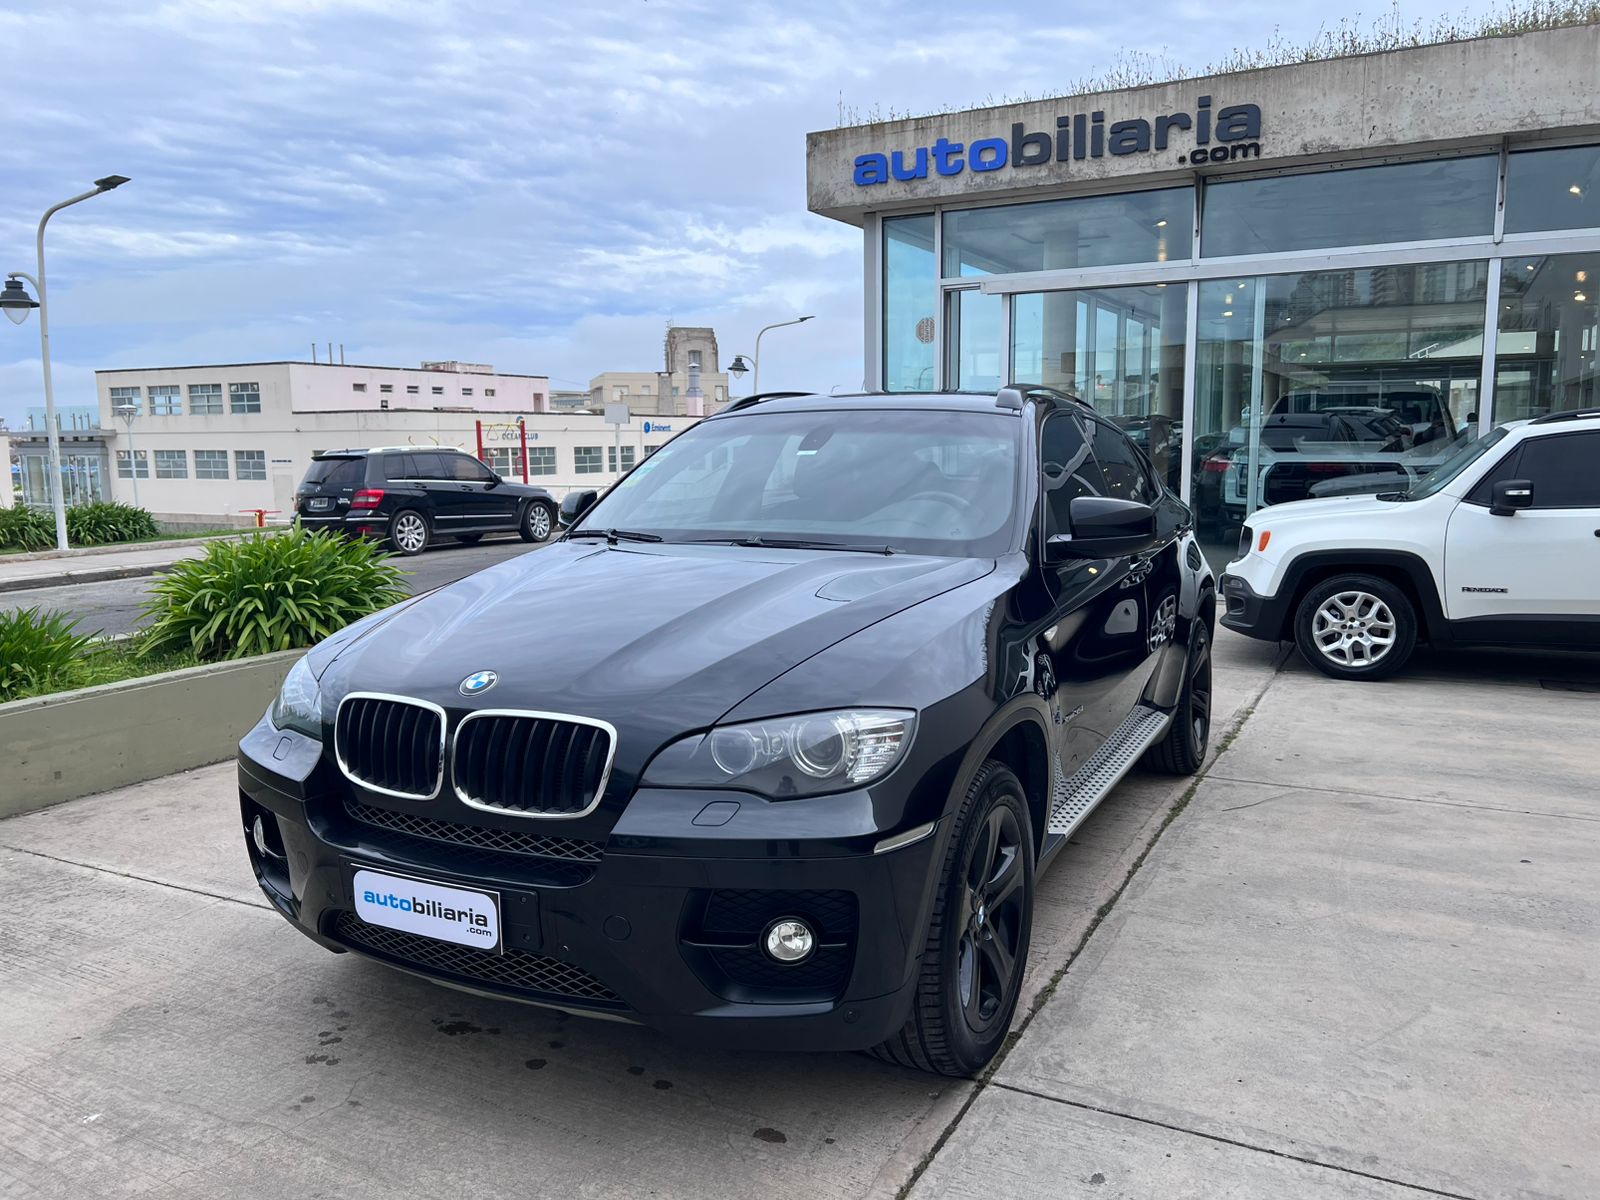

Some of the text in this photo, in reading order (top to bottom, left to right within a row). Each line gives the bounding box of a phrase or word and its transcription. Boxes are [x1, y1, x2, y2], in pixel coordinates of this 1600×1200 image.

[853, 96, 1262, 187] autobiliaria
[1179, 140, 1260, 165] .com
[363, 890, 488, 928] autobiliaria
[466, 927, 492, 937] .com
